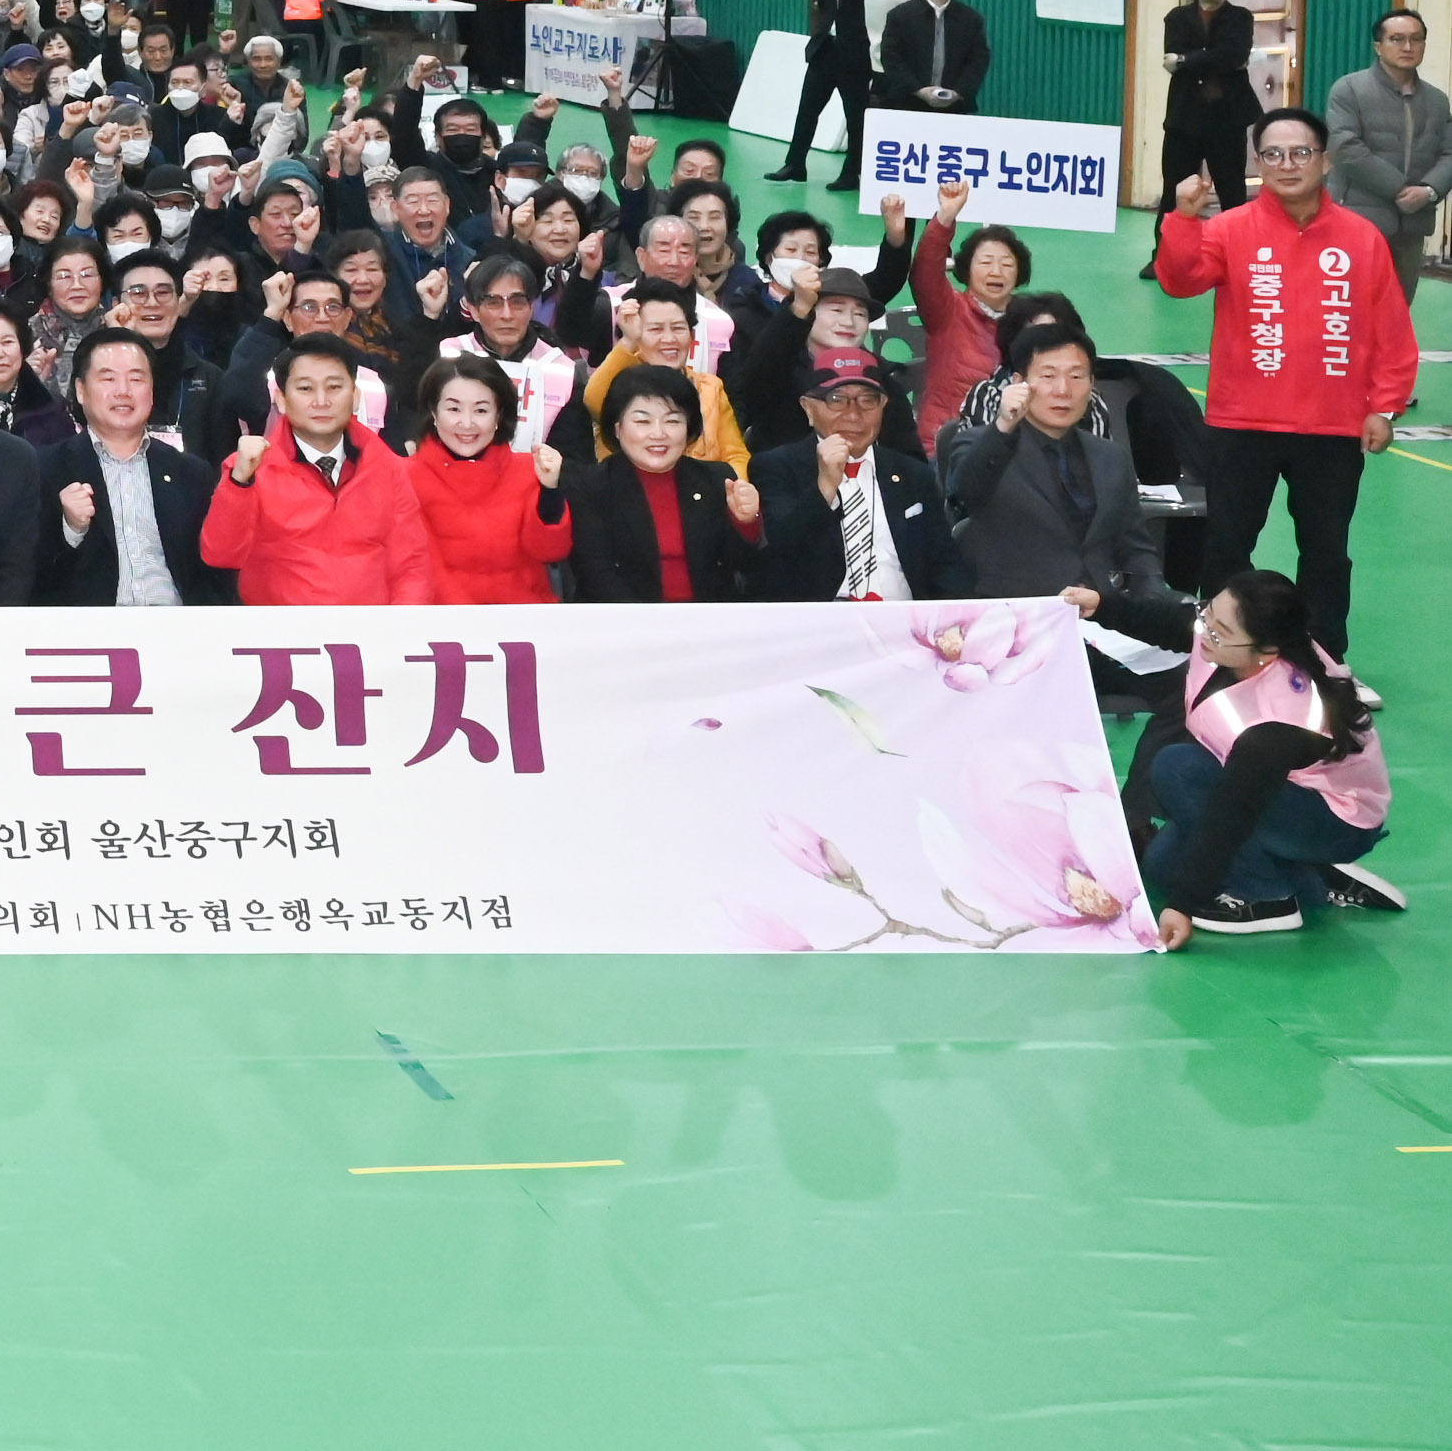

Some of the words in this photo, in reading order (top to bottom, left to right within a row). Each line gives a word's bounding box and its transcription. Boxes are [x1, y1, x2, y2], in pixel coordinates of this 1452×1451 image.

[530, 23, 624, 64] 노인교구지도사
[875, 140, 930, 185] 울산
[936, 145, 990, 189] 중구
[997, 150, 1106, 198] 노인지회
[1248, 274, 1285, 371] 중구청장
[1321, 279, 1352, 377] 고호근
[14, 647, 154, 777] 큰
[231, 641, 545, 776] 잔치
[91, 818, 340, 860] 울산중구지회
[92, 895, 513, 934] NH농협은행옥교동지점
